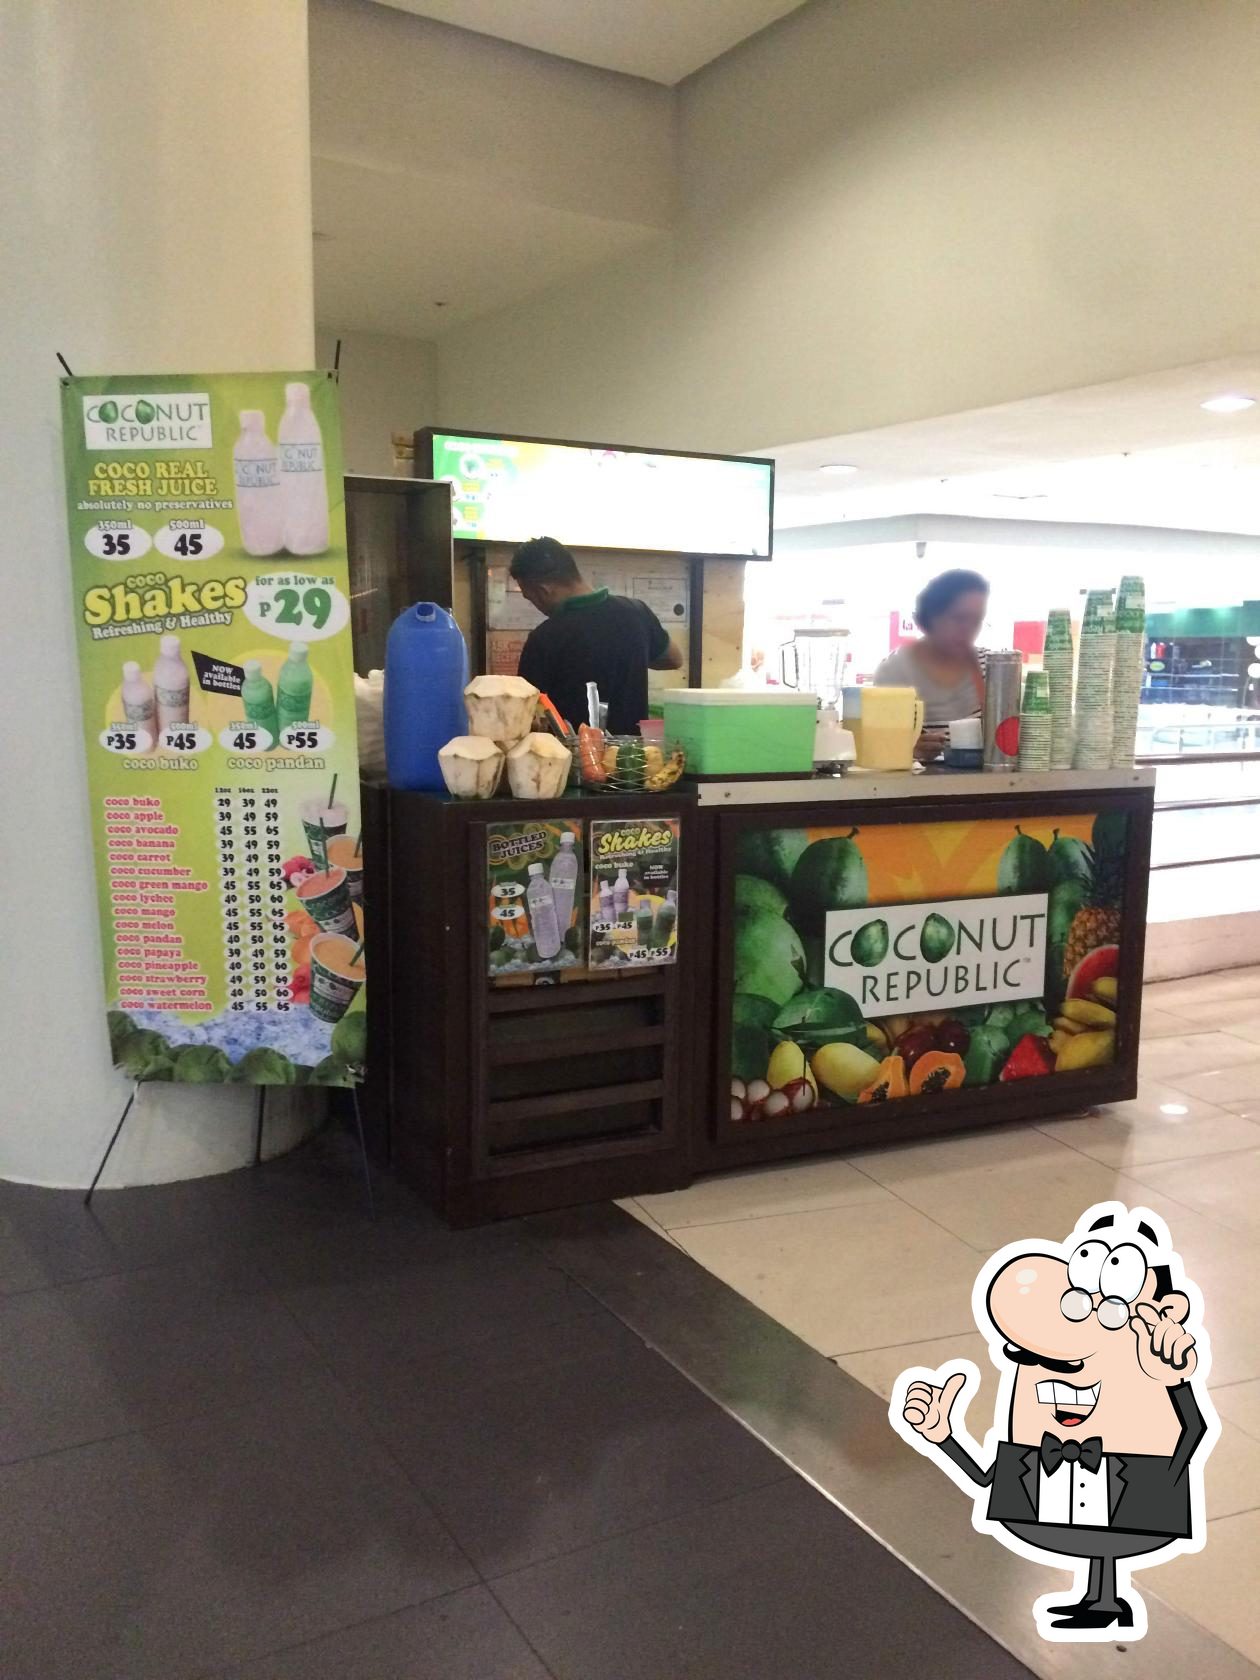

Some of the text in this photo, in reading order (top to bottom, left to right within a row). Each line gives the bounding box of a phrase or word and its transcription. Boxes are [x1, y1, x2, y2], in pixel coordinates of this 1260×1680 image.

[86, 399, 208, 425] COCONUT
[106, 425, 198, 442] REPUBLIC
[94, 462, 208, 478] COCO REAL
[88, 479, 217, 496] FRESH JUICE
[77, 500, 233, 512] absolutely no preservatives
[98, 520, 132, 530] 350ml
[169, 519, 205, 529] 500ml
[102, 533, 131, 555] 35
[174, 533, 203, 556] 45
[255, 575, 335, 586] for as low as
[84, 577, 247, 626] Shakes
[92, 611, 233, 640] Refreshing & Healthy
[212, 664, 234, 674] NOW
[204, 671, 241, 683] available
[213, 680, 241, 690] bottles
[107, 733, 136, 750] P35
[166, 733, 196, 750] P45
[233, 732, 256, 750] 45
[287, 732, 318, 748] P55
[123, 757, 198, 770] coco buko
[227, 756, 325, 771] coco pandan
[106, 798, 277, 808] coco buko 29 39 49
[134, 811, 163, 822] apple
[218, 812, 231, 821] 39
[243, 812, 256, 821] 49
[265, 812, 278, 821] 59
[135, 825, 178, 835] avocado
[220, 826, 232, 835] 45
[244, 826, 256, 835] 55
[266, 825, 279, 835] 65
[136, 839, 175, 848] banana
[221, 840, 233, 849] 39
[245, 840, 258, 849] 49
[267, 840, 280, 849] 59
[492, 831, 547, 852] BOTTLED
[598, 828, 672, 854] Shakes
[501, 840, 543, 859] JUICES
[222, 854, 234, 862] 39
[246, 854, 259, 863] 49
[268, 854, 280, 863] 59
[138, 867, 191, 876] cucumber
[222, 867, 235, 876] 39
[246, 868, 259, 876] 49
[269, 868, 281, 876] 59
[139, 881, 168, 889] green
[172, 882, 208, 891] mango
[224, 881, 236, 890] 45
[248, 881, 260, 890] 55
[269, 881, 282, 890] 65
[500, 887, 516, 897] 35
[140, 893, 174, 903] lychee
[225, 895, 237, 904] 40
[249, 895, 261, 904] 50
[270, 895, 283, 903] 60
[141, 908, 176, 917] mango
[226, 908, 238, 917] 45
[250, 908, 262, 917] 55
[272, 908, 284, 917] 65
[500, 909, 515, 918] 45
[142, 921, 174, 930] melon
[226, 922, 239, 931] 45
[250, 922, 263, 931] 55
[273, 922, 285, 931] 65
[143, 934, 182, 944] pandan
[227, 935, 240, 944] 40
[251, 935, 264, 944] 50
[273, 935, 286, 944] 60
[828, 912, 1046, 968] COCONUT
[144, 949, 181, 957] papaya
[228, 949, 241, 958] 39
[252, 949, 264, 958] 49
[274, 949, 286, 958] 59
[145, 961, 198, 971] pineapple
[229, 962, 241, 970] 40
[252, 962, 265, 970] 50
[275, 962, 287, 970] 60
[145, 975, 206, 984] strawberry
[229, 976, 243, 984] 49
[254, 976, 266, 984] 59
[276, 976, 288, 984] 69
[862, 959, 1021, 1005] REPUBLIC
[230, 989, 243, 997] 40
[255, 989, 267, 997] 50
[276, 989, 289, 997] 60
[147, 1001, 212, 1009] watermelon
[231, 1002, 244, 1011] 45
[255, 1002, 268, 1011] 55
[277, 1002, 290, 1011] 65
